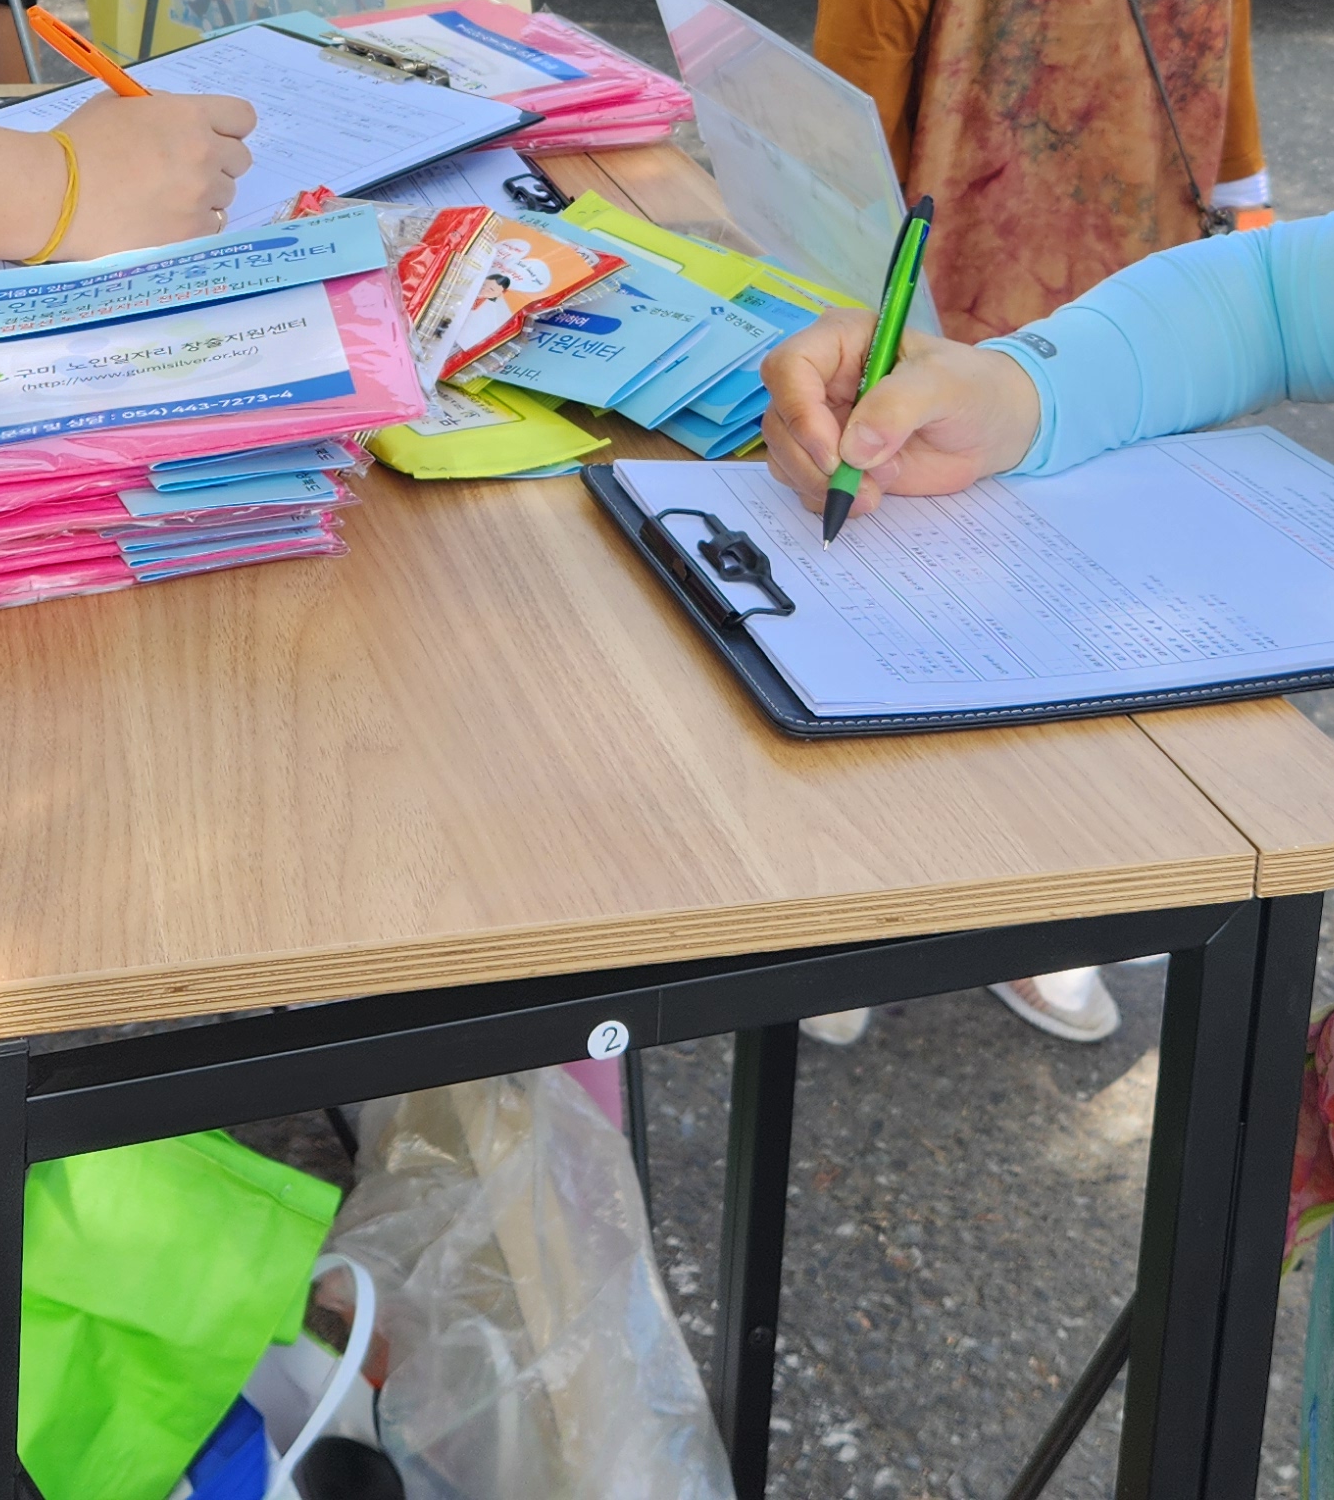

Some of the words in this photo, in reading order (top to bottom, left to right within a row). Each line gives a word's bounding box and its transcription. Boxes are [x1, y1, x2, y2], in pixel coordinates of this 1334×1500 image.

[147, 242, 337, 286] 창출지원센터
[14, 365, 58, 381] 구미
[67, 345, 174, 373] 노인일자리
[180, 317, 309, 353] 창출지원센터
[121, 405, 168, 420] 054)
[602, 1026, 621, 1053] 2
